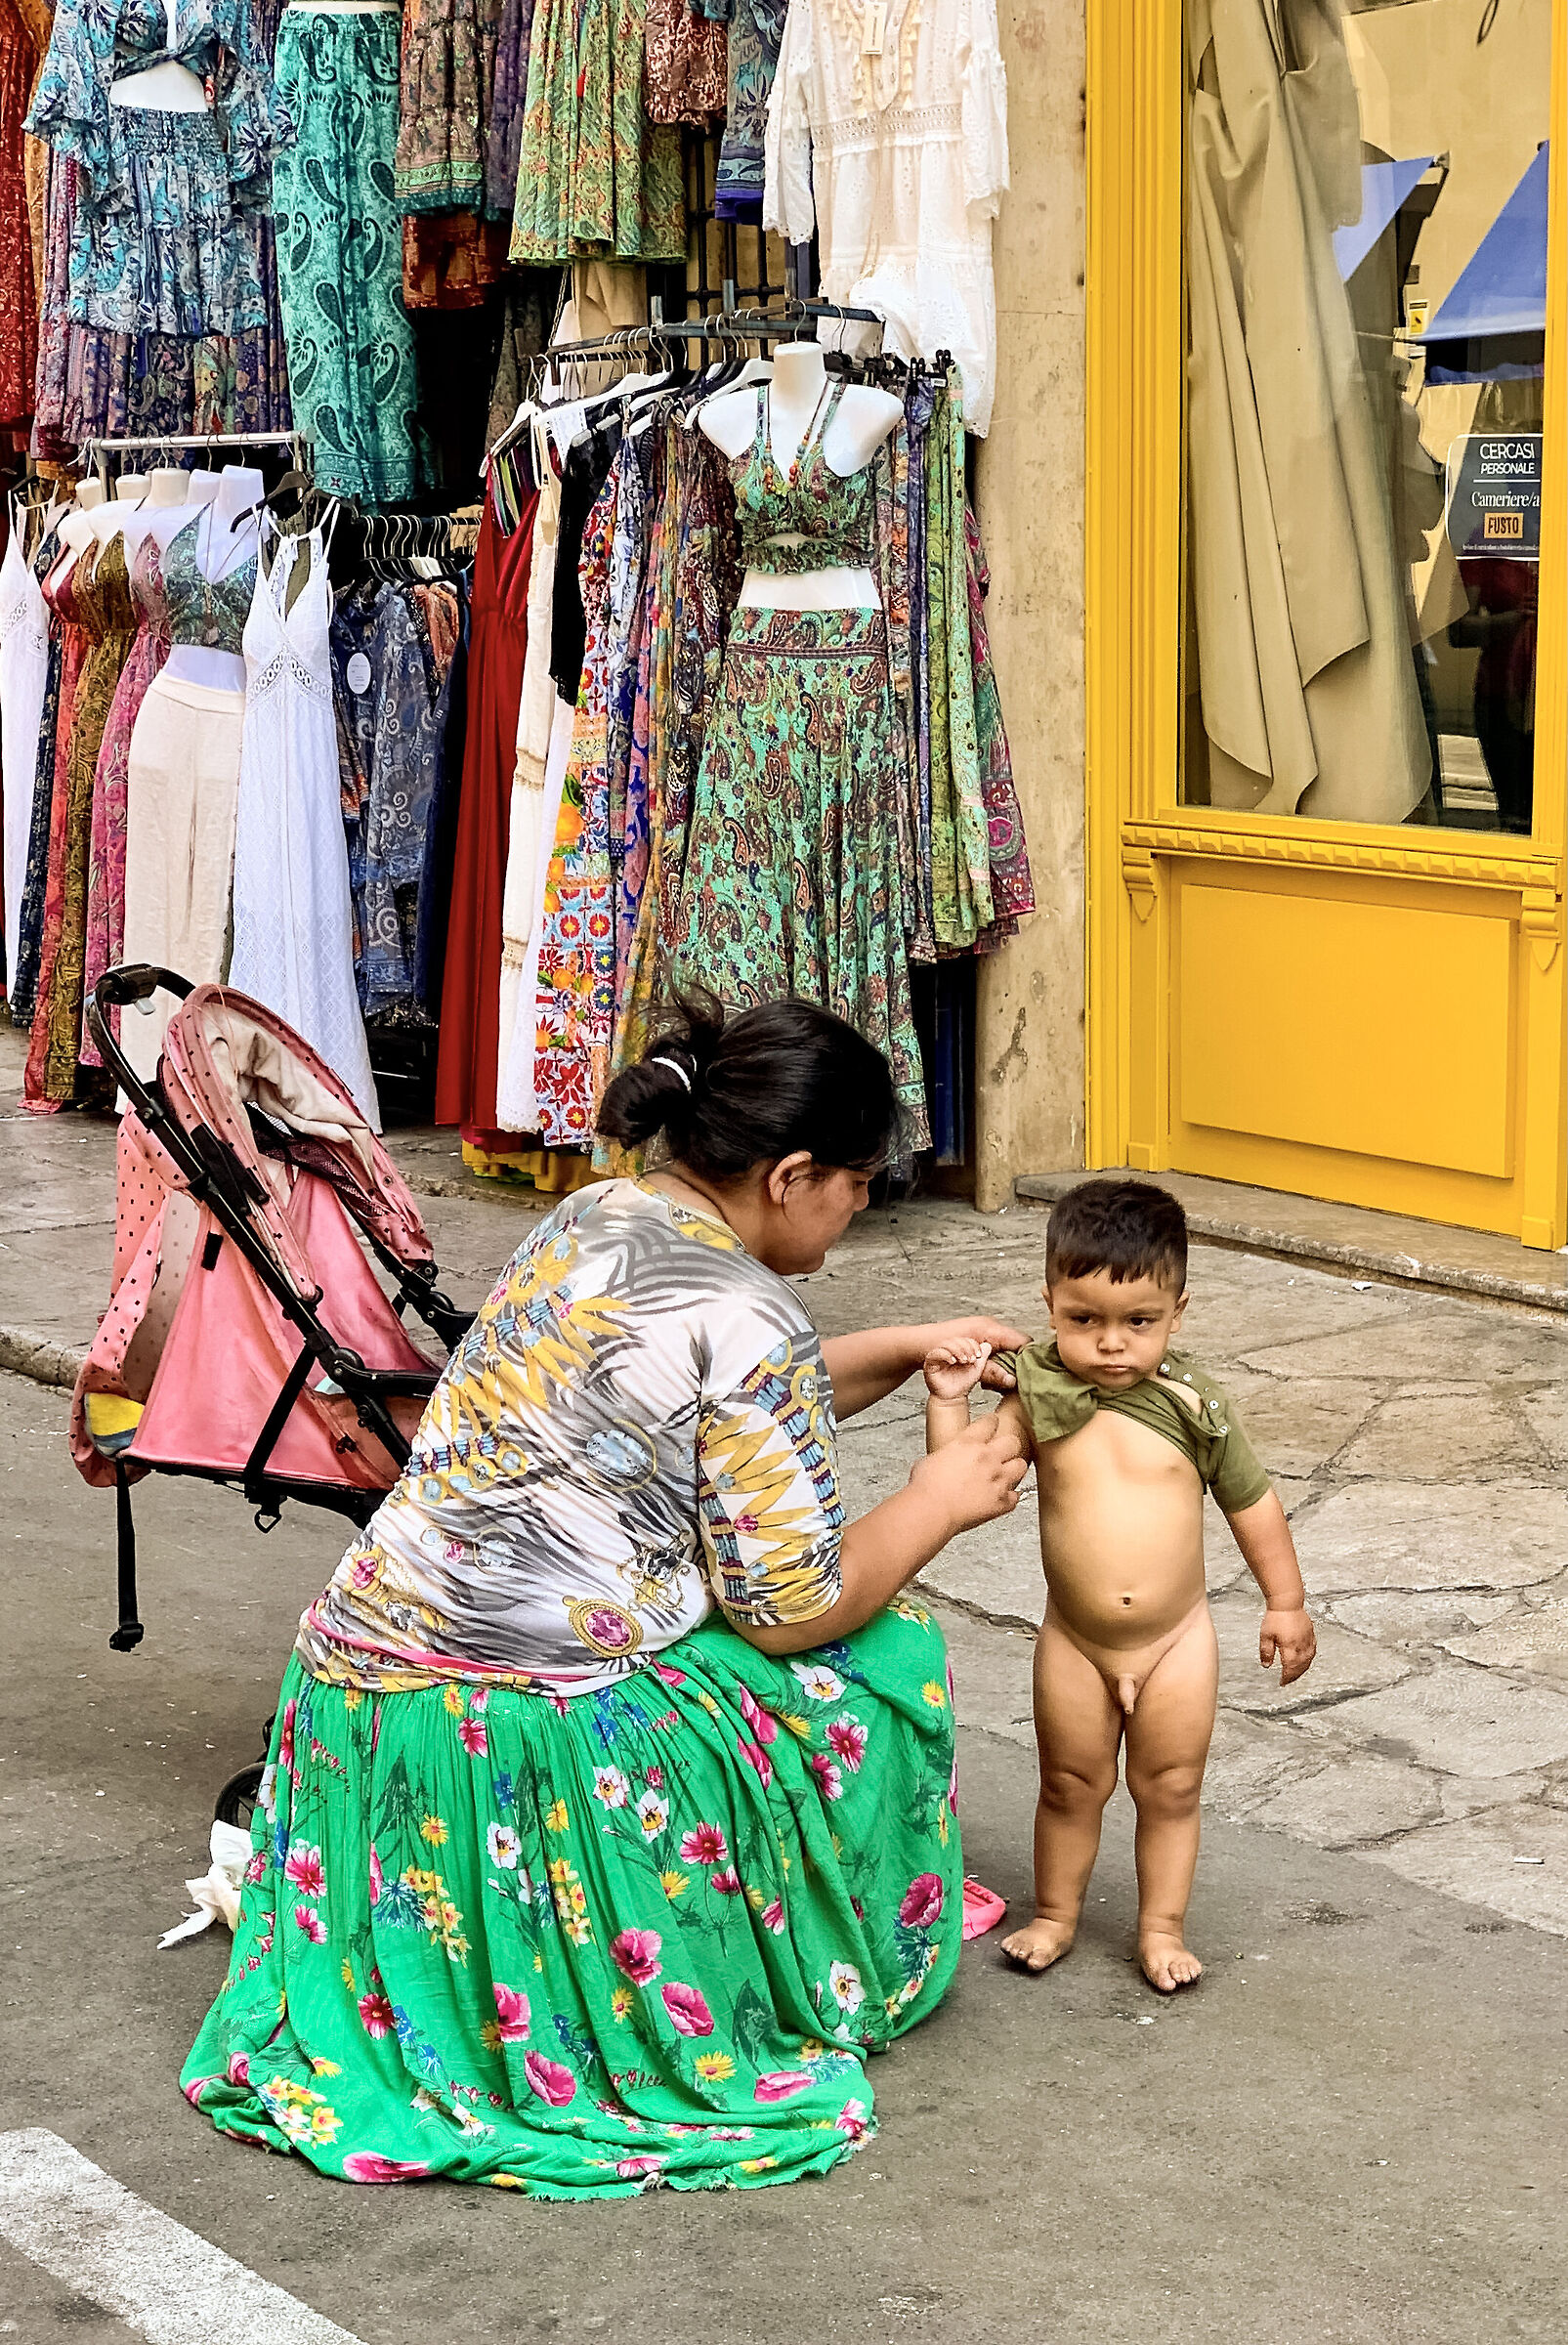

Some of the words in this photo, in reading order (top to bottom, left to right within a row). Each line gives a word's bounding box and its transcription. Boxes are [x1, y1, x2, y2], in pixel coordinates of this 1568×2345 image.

[1479, 443, 1535, 459] CERCASI
[1480, 463, 1535, 475] PERSONALE
[1471, 490, 1540, 507] Cameriere/a
[1488, 516, 1519, 533] FUSTO
